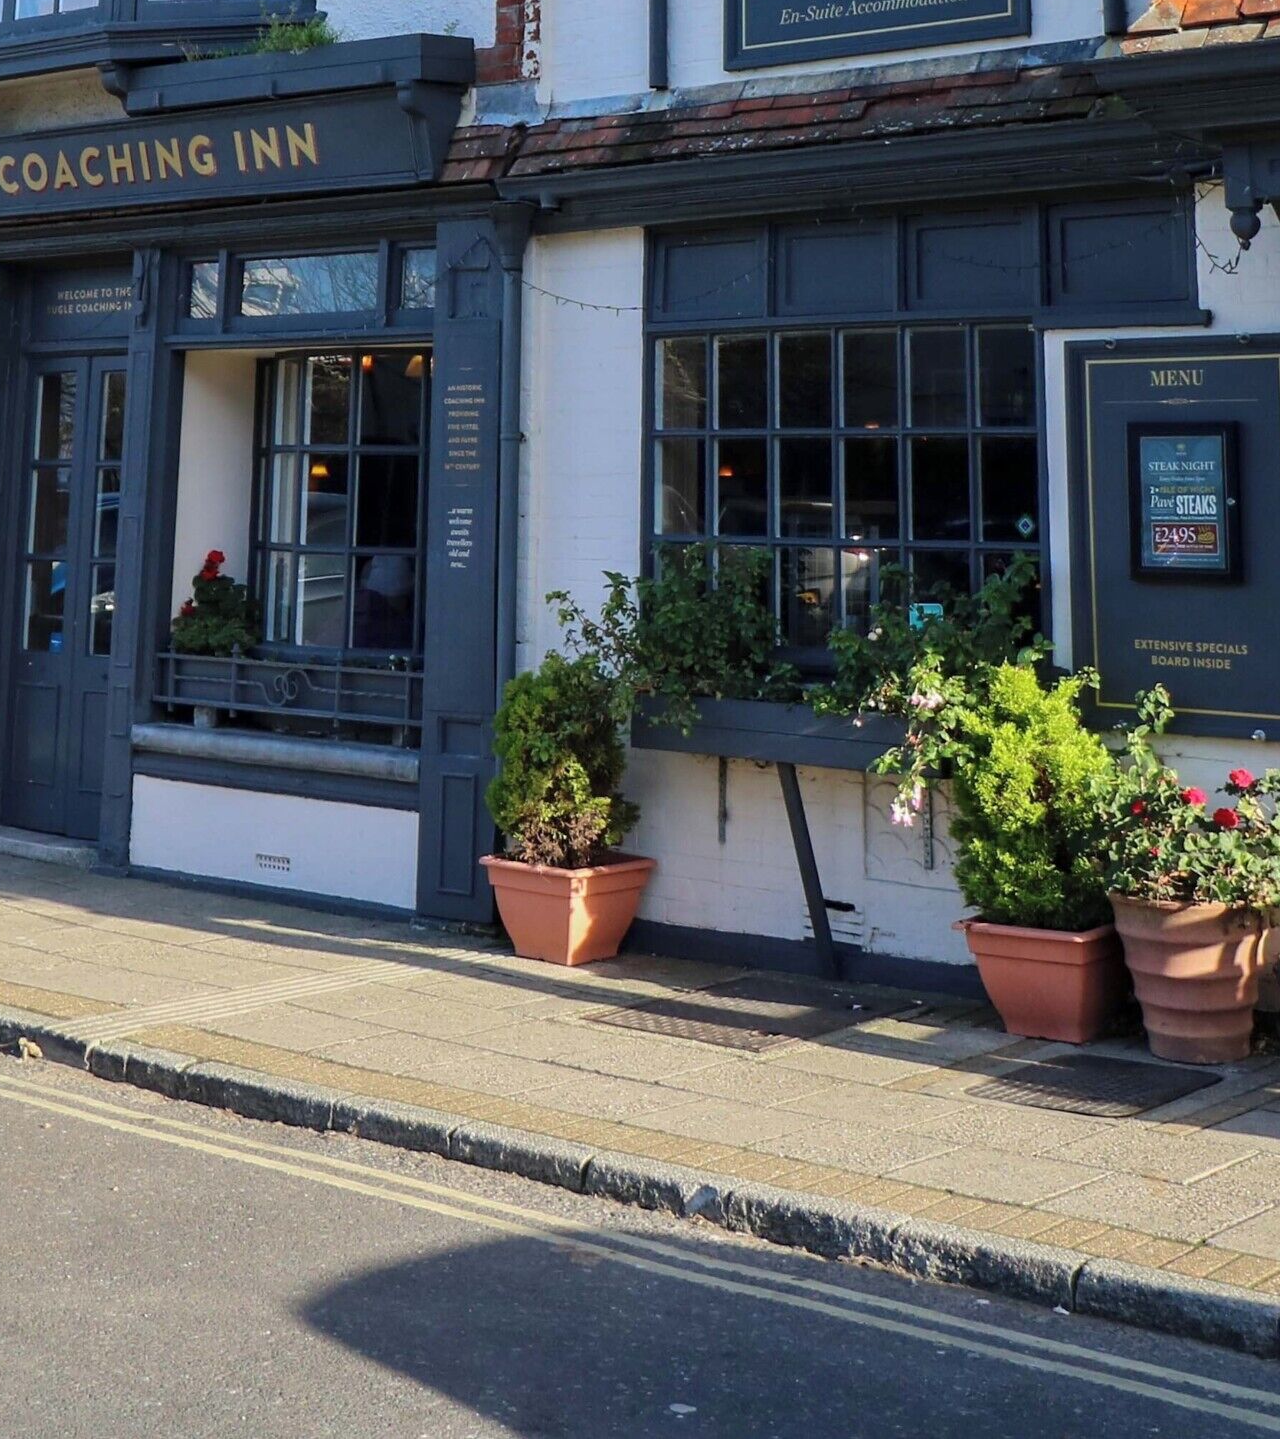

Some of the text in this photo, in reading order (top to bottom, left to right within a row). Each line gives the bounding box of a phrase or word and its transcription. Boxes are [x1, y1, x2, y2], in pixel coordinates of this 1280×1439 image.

[779, 2, 844, 25] En-Suite
[233, 122, 318, 171] INN
[57, 287, 132, 300] WELCOME TO THE
[76, 301, 121, 313] COACHING
[1150, 369, 1204, 386] MENU
[1148, 460, 1216, 471] STEAK NIGHT
[1176, 494, 1217, 515] STEAKS
[1134, 639, 1248, 655] EXTENSIVE SPECIALS
[1151, 655, 1231, 670] BOARD INSIDE
